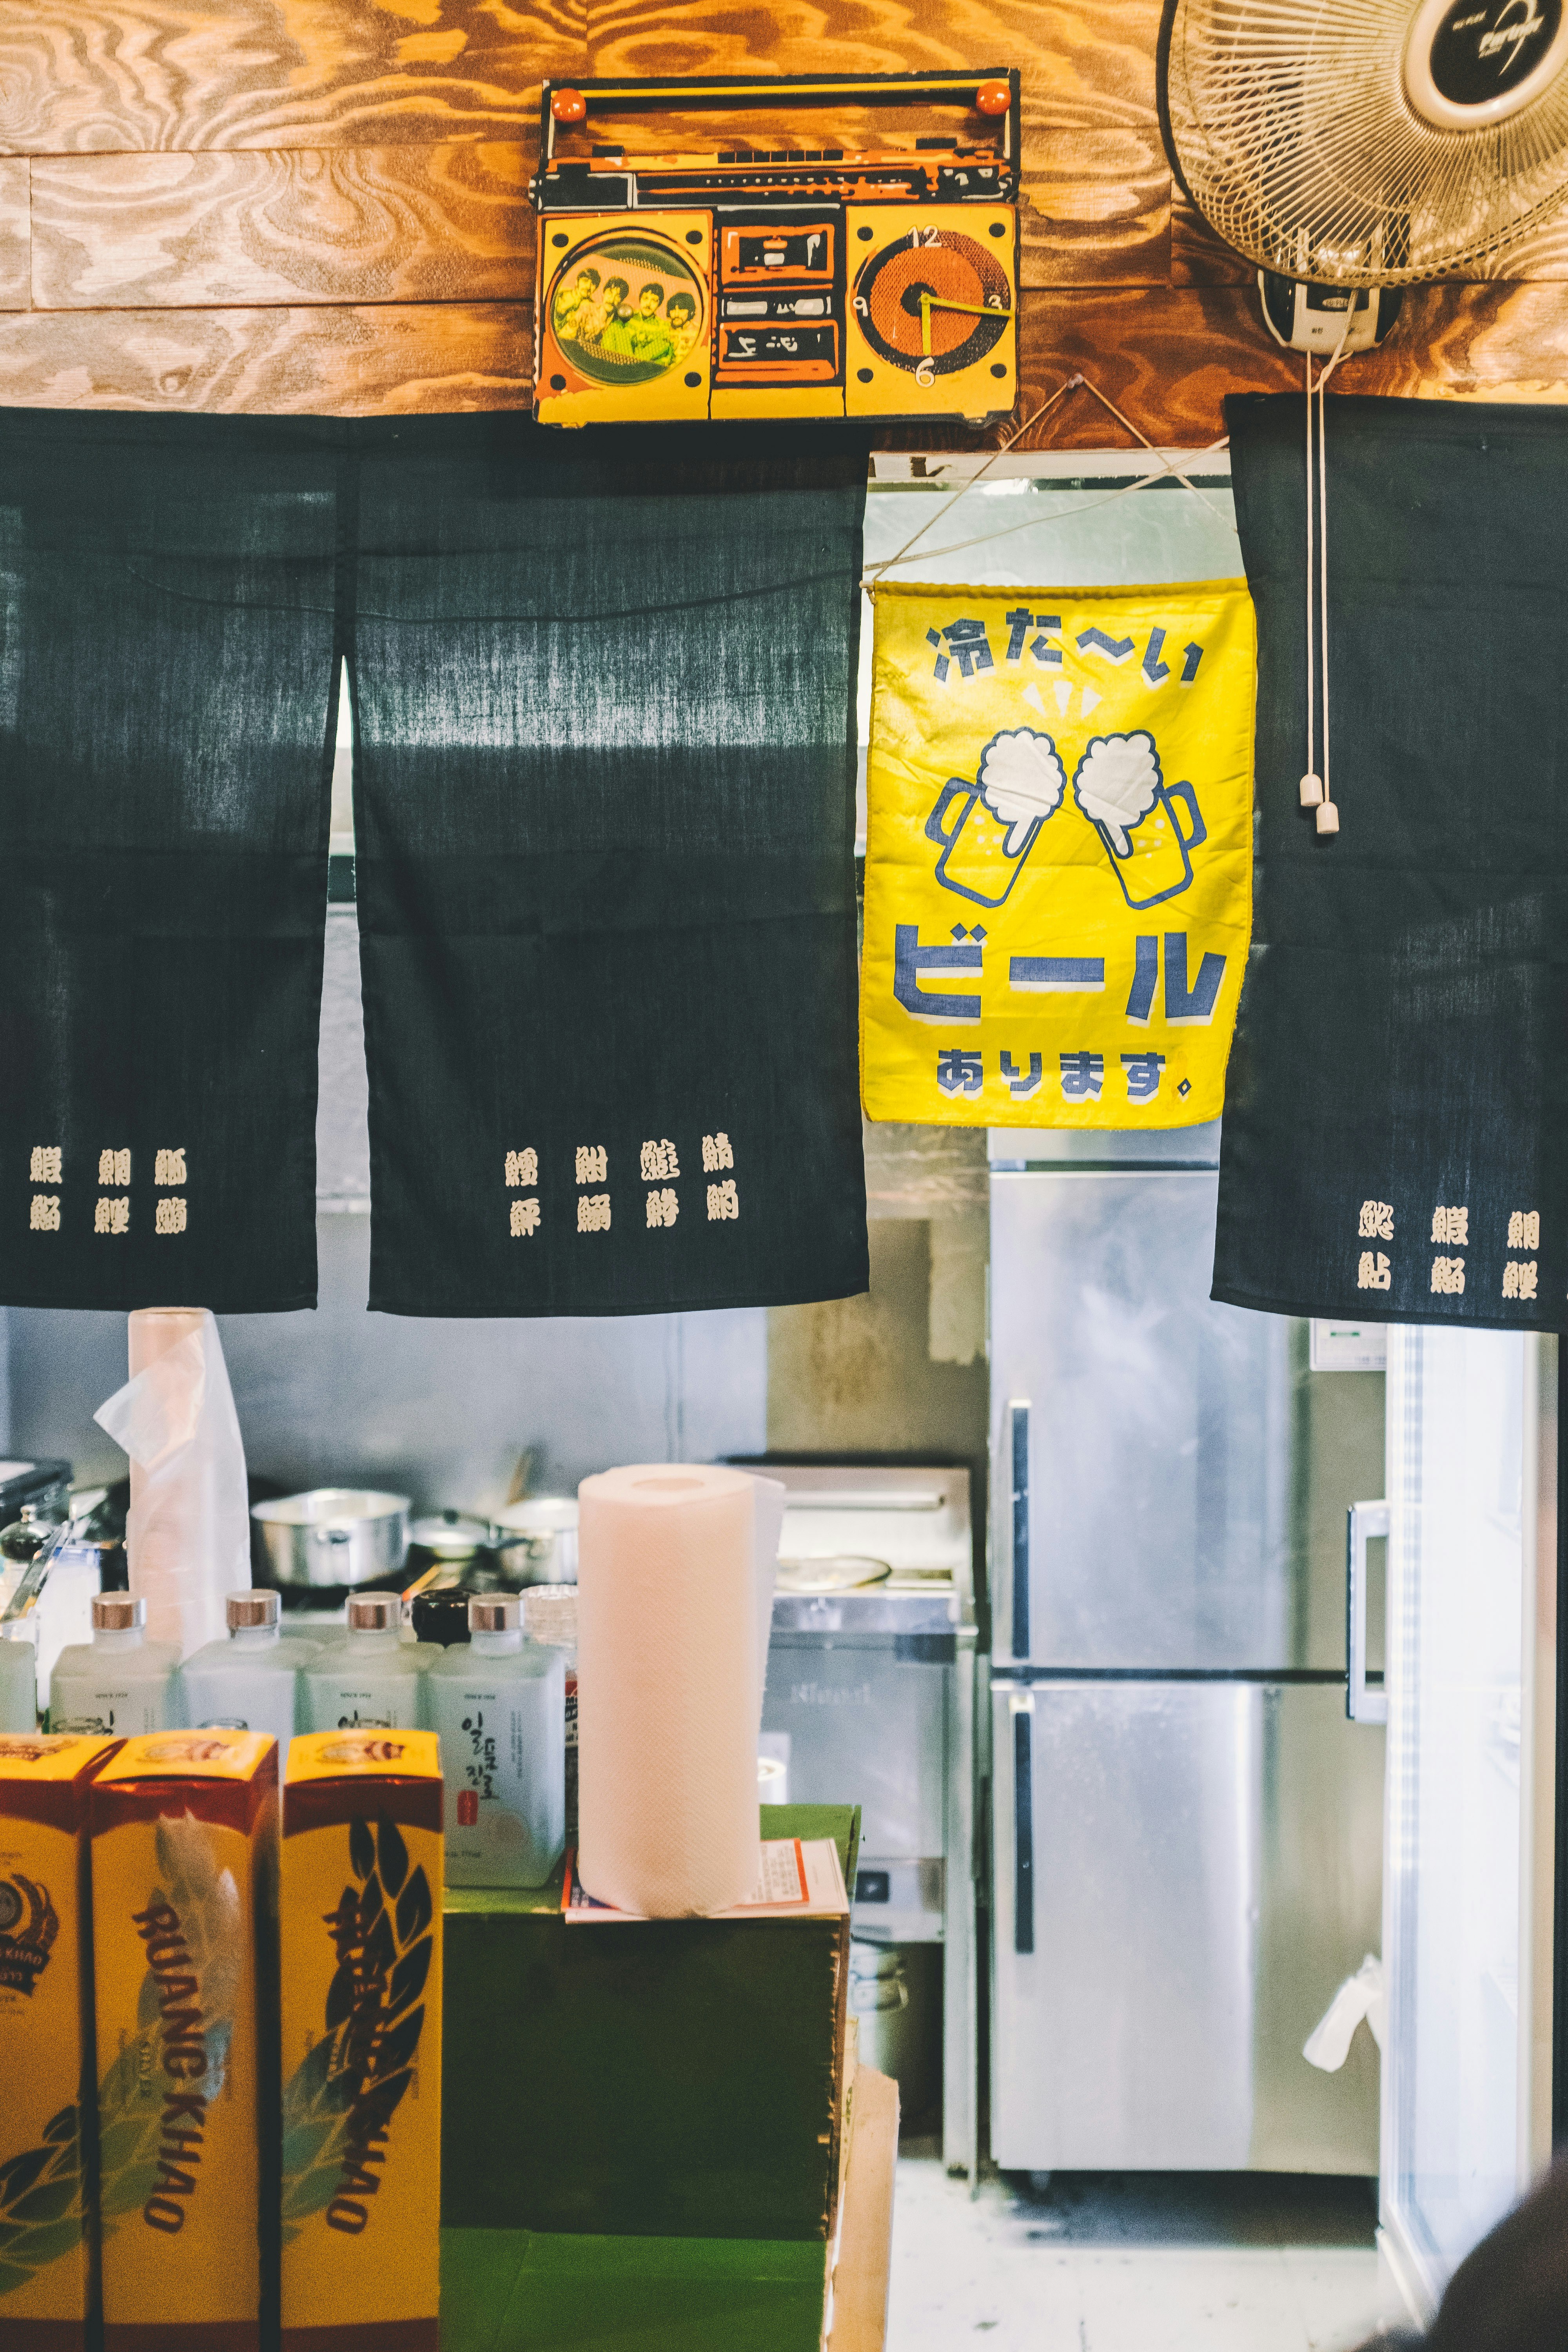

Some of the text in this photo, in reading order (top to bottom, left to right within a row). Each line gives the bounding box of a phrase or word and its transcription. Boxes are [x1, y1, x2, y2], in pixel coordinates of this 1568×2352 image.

[908, 225, 942, 248] 12
[853, 296, 868, 316] 9
[988, 295, 1002, 310] 3
[915, 357, 935, 387] 6
[894, 923, 1226, 1020] ビール
[937, 1049, 1191, 1097] あります。
[702, 1132, 733, 1172] 鯖
[1357, 1252, 1391, 1290] 鮎
[132, 1904, 208, 2234] RUANG KHAO
